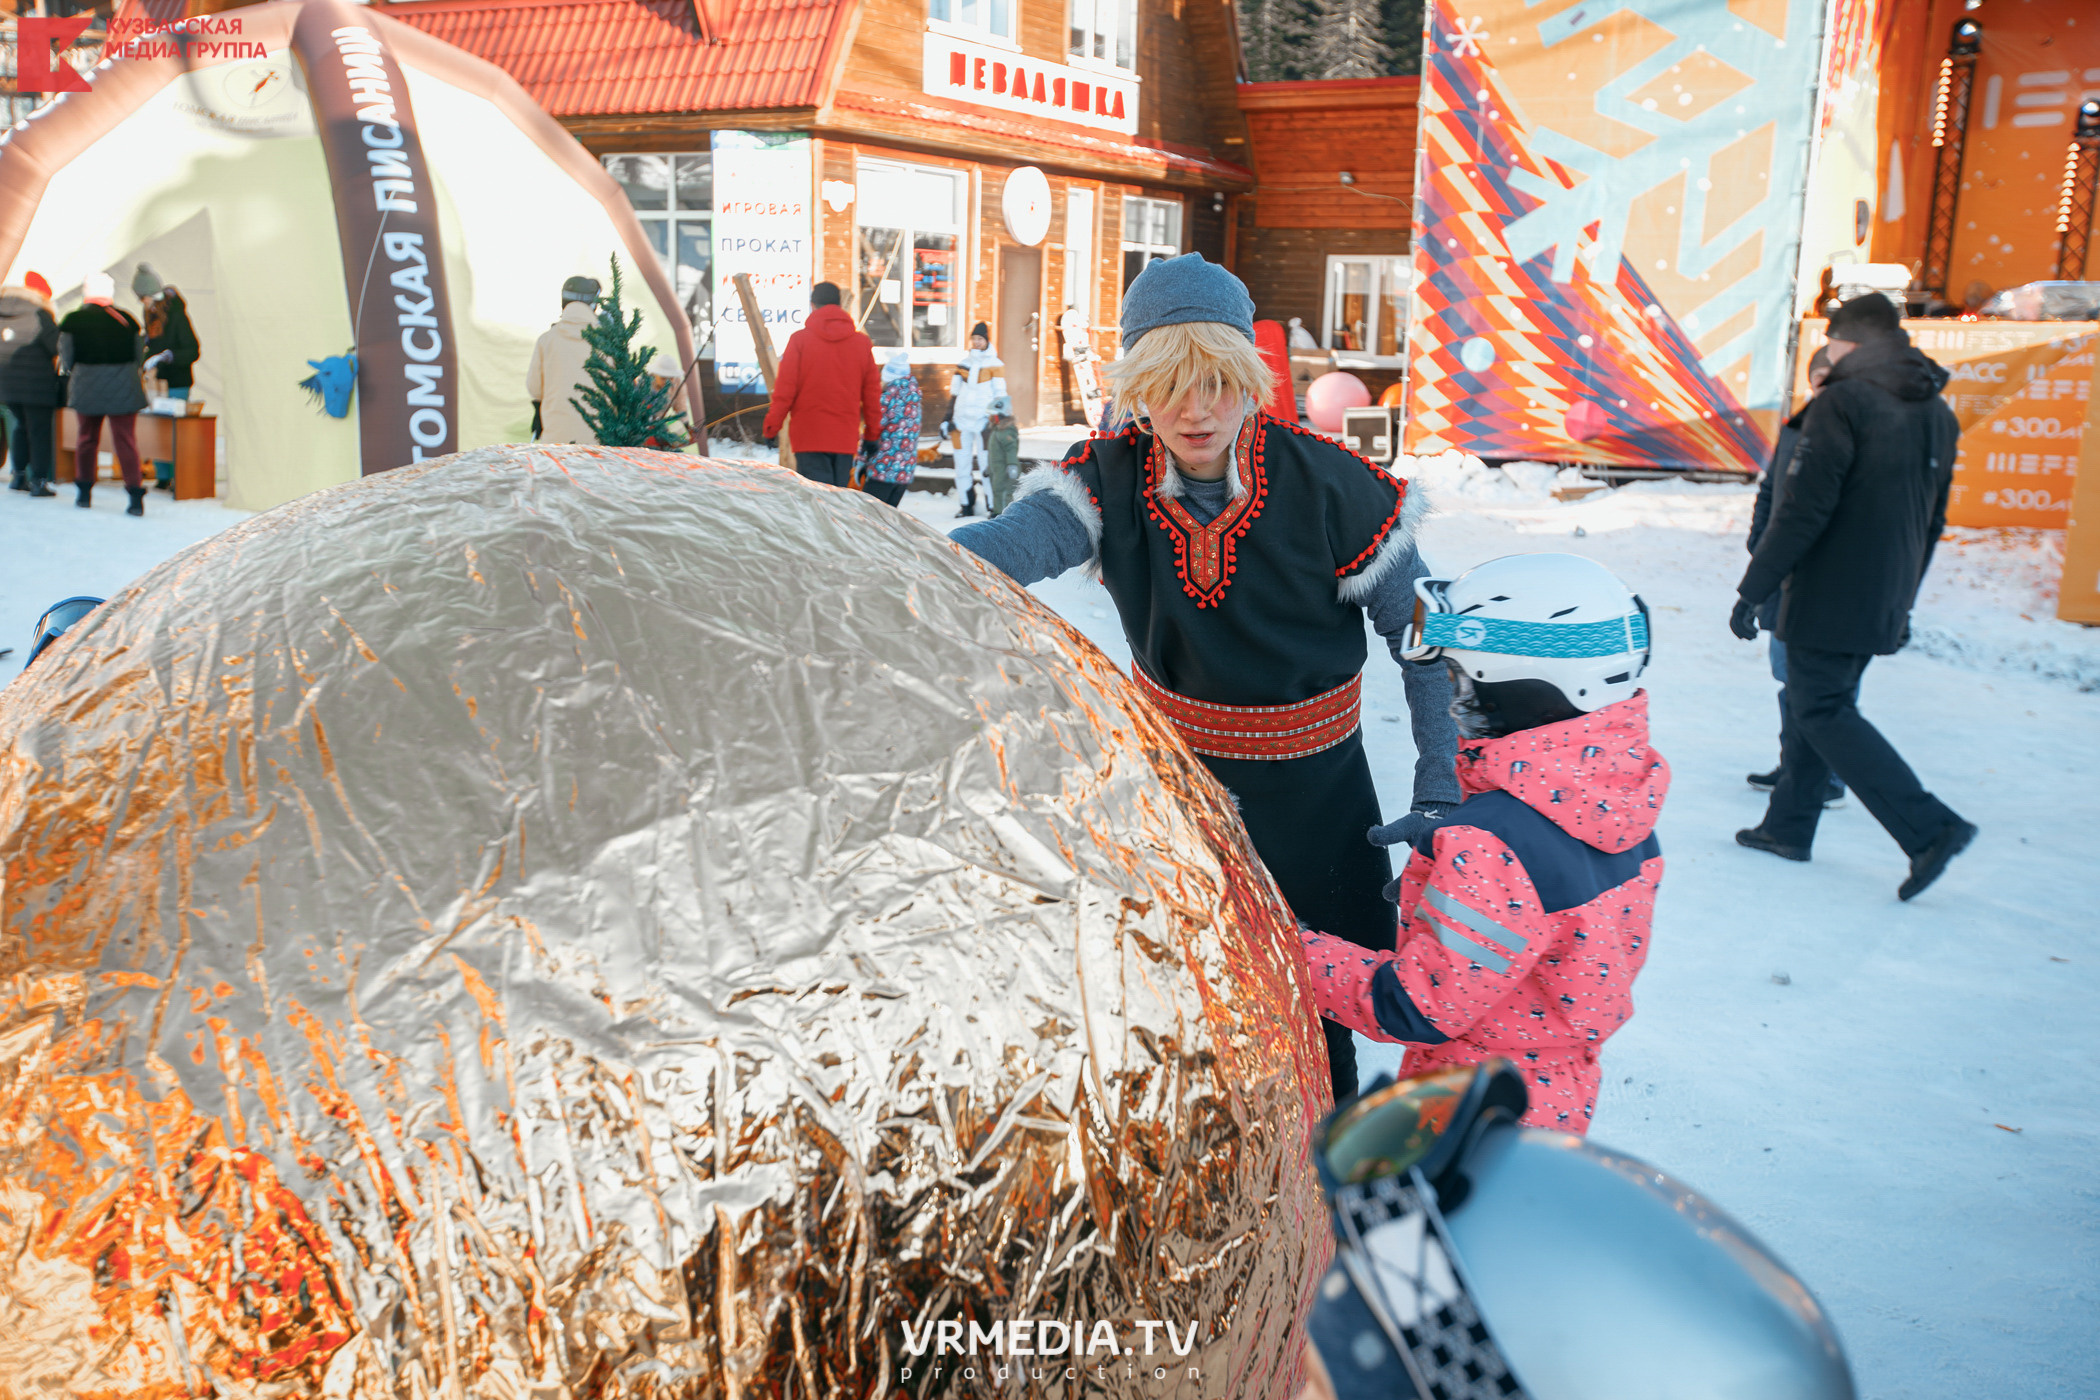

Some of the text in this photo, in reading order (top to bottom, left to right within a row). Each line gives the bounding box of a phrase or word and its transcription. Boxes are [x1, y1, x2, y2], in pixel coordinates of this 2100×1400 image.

[722, 202, 802, 215] ИГРОВАЯ
[721, 238, 802, 253] ПРОКАТ
[722, 307, 802, 323] СЕВИС
